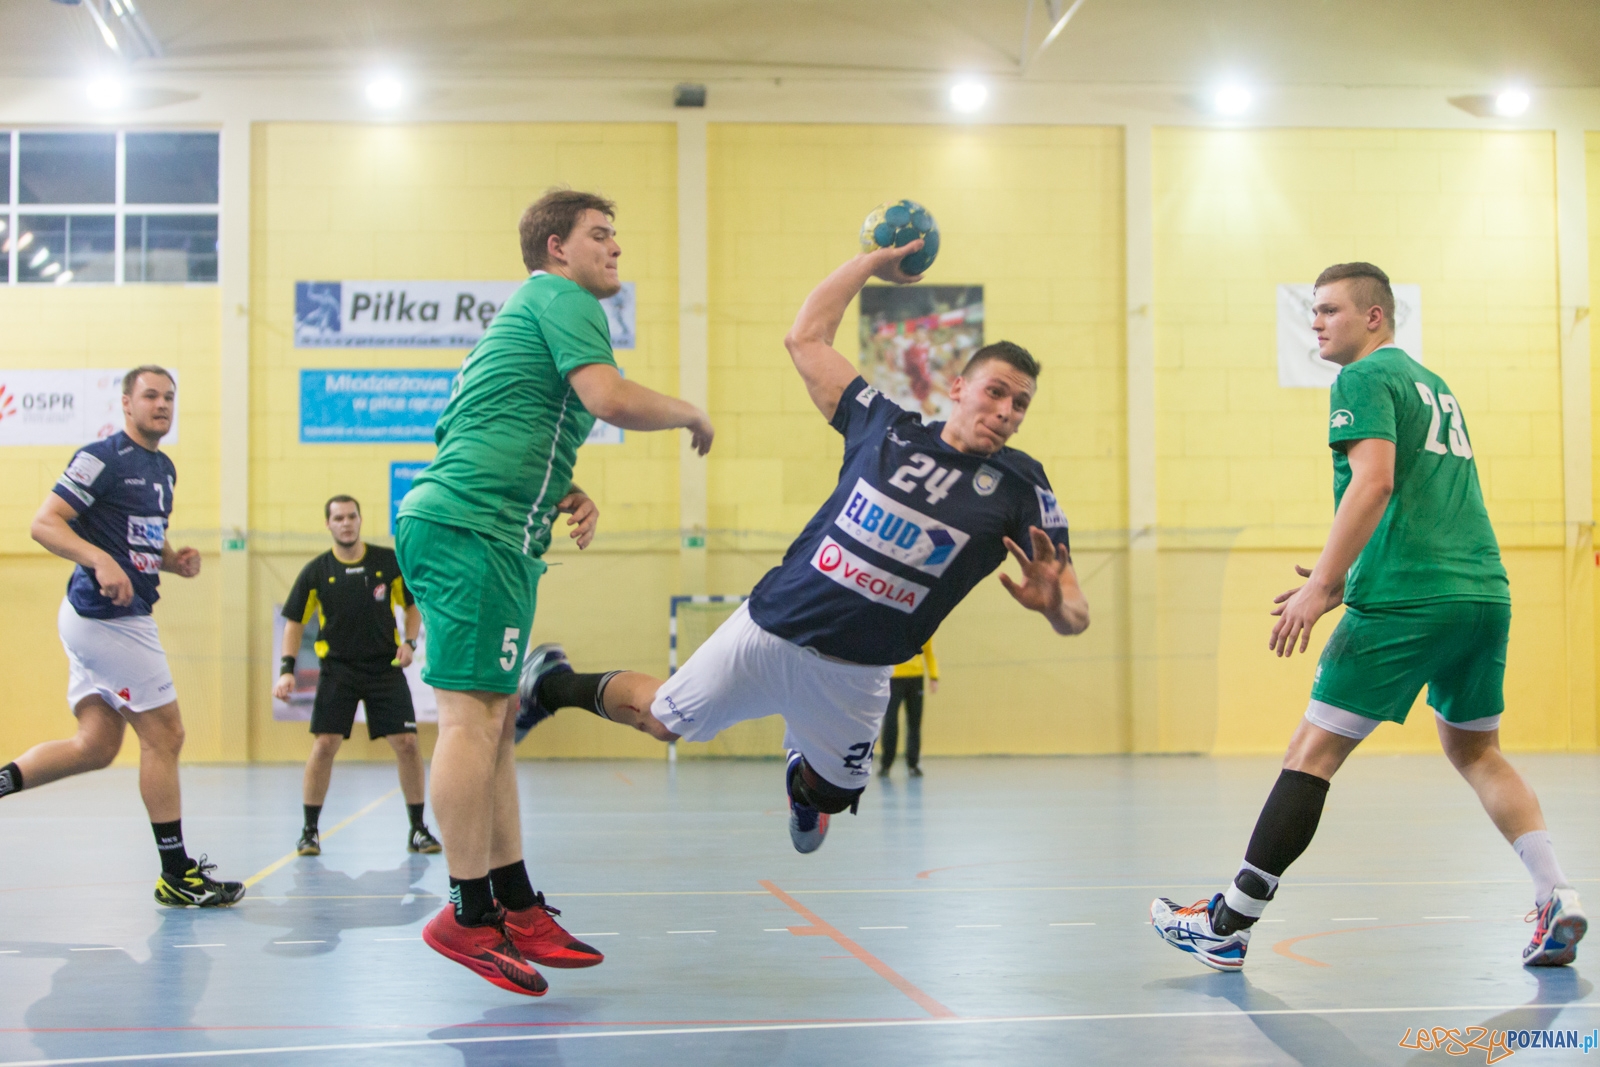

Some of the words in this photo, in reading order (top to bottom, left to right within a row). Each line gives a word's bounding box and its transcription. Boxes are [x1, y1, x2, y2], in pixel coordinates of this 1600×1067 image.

[350, 291, 440, 322] Piłka
[454, 293, 505, 330] Rę
[22, 393, 74, 410] OSPR
[1415, 381, 1473, 460] 23
[153, 482, 165, 512] 7
[888, 452, 963, 505] 24
[845, 491, 922, 550] ELBUD
[844, 562, 917, 608] VEOLIA
[499, 626, 521, 672] 5
